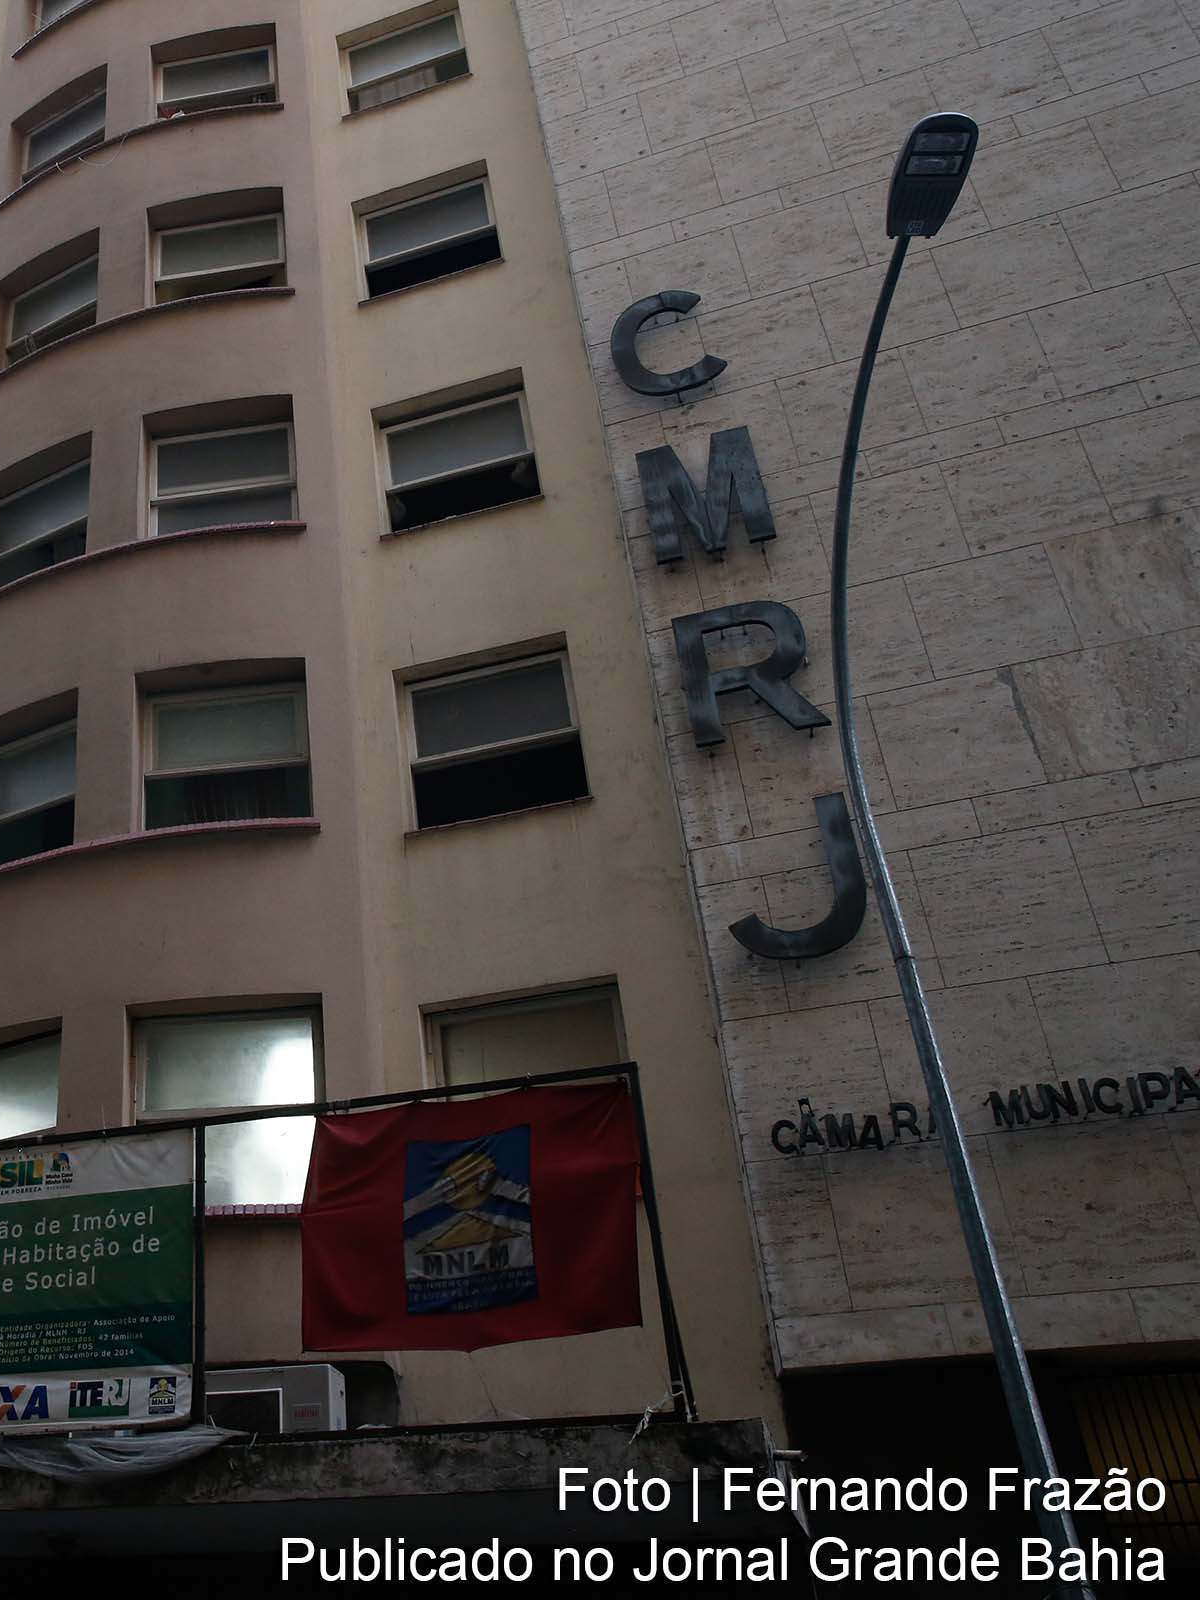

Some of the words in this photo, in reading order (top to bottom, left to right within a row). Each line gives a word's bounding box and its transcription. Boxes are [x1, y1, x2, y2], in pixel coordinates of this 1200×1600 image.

[771, 1098, 937, 1155] CÂMAR
[34, 1217, 62, 1236] de
[72, 1205, 154, 1232] Imóvel
[3, 1236, 120, 1265] Habitação
[132, 1233, 160, 1254] de
[25, 1265, 96, 1291] Social
[152, 1313, 176, 1324] Apoio
[7, 1330, 36, 1340] Moradia
[59, 1349, 99, 1360] Novembro
[114, 1347, 135, 1357] 2014
